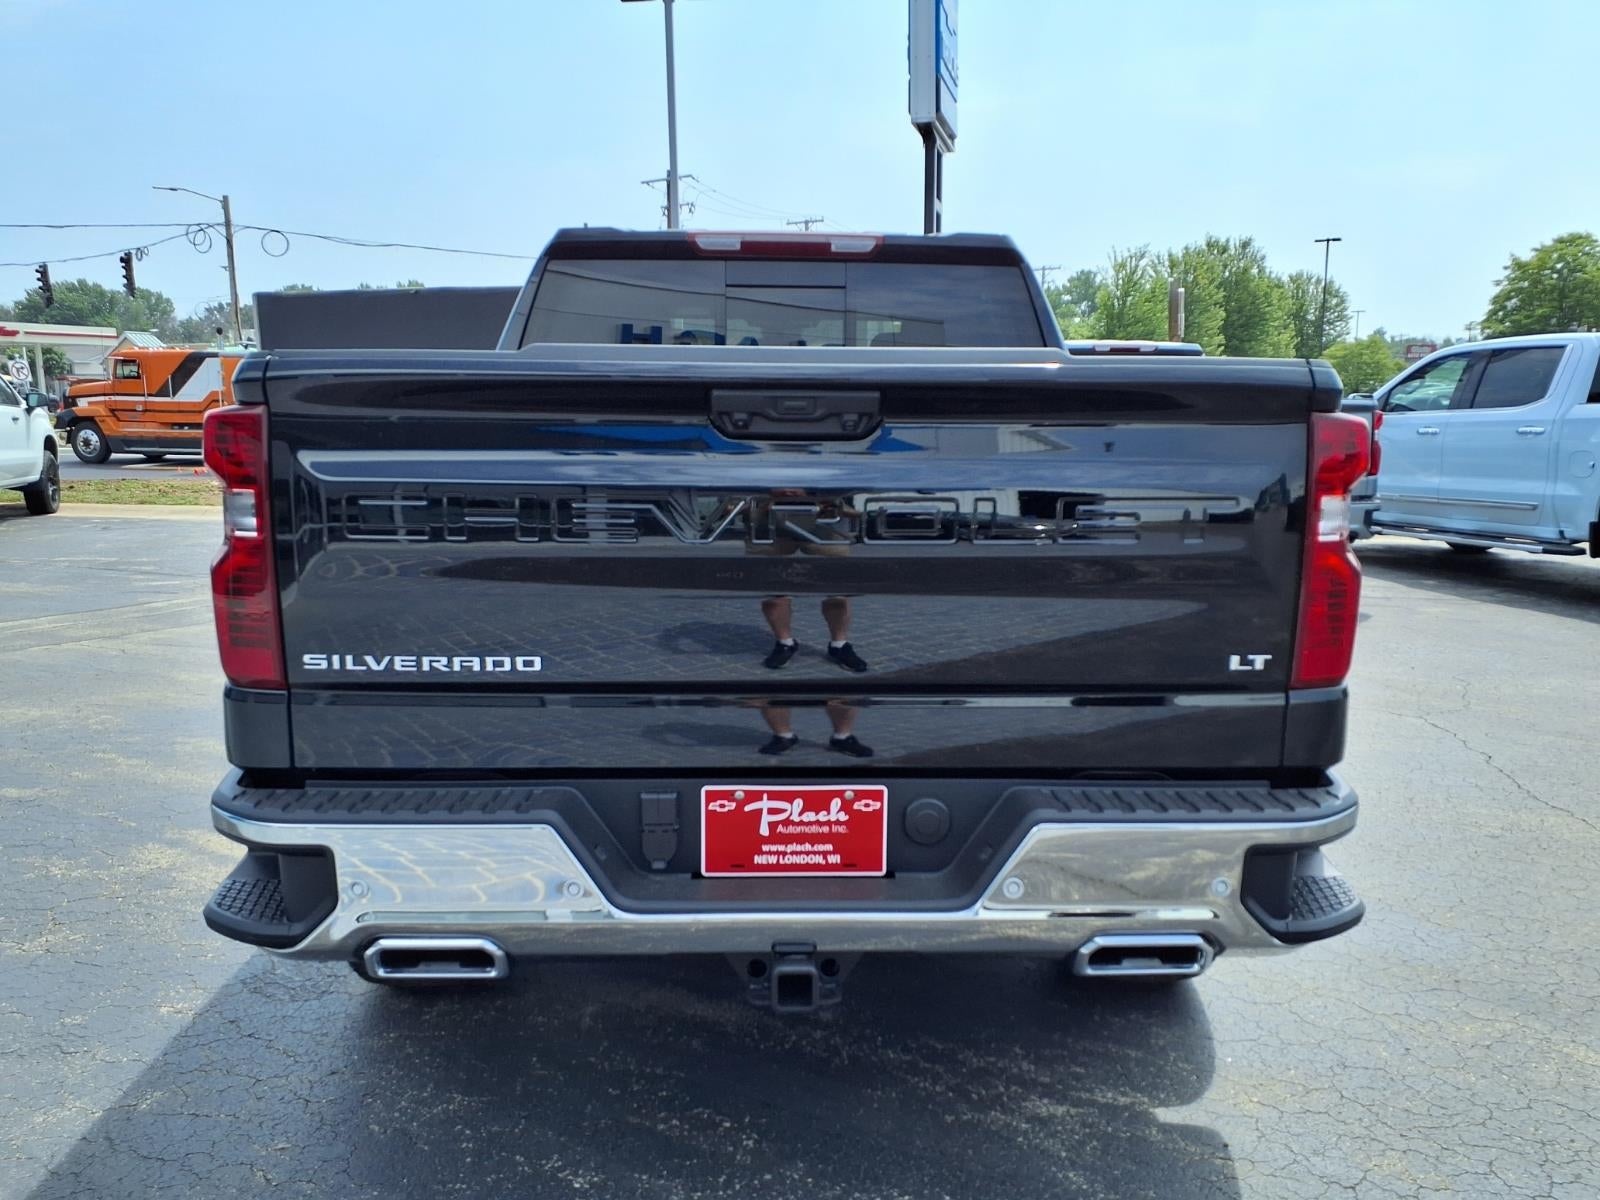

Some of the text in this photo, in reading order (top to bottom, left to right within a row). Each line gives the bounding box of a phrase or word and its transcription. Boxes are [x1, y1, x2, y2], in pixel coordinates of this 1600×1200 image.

[343, 491, 1240, 544] CHEVROLET
[303, 654, 541, 672] SILVERADO
[1229, 654, 1272, 671] LT
[744, 793, 849, 837] Plach
[776, 824, 848, 834] Automotive Inc.
[762, 842, 833, 853] www.plach.com
[754, 855, 840, 865] NEW LONDON, WI
